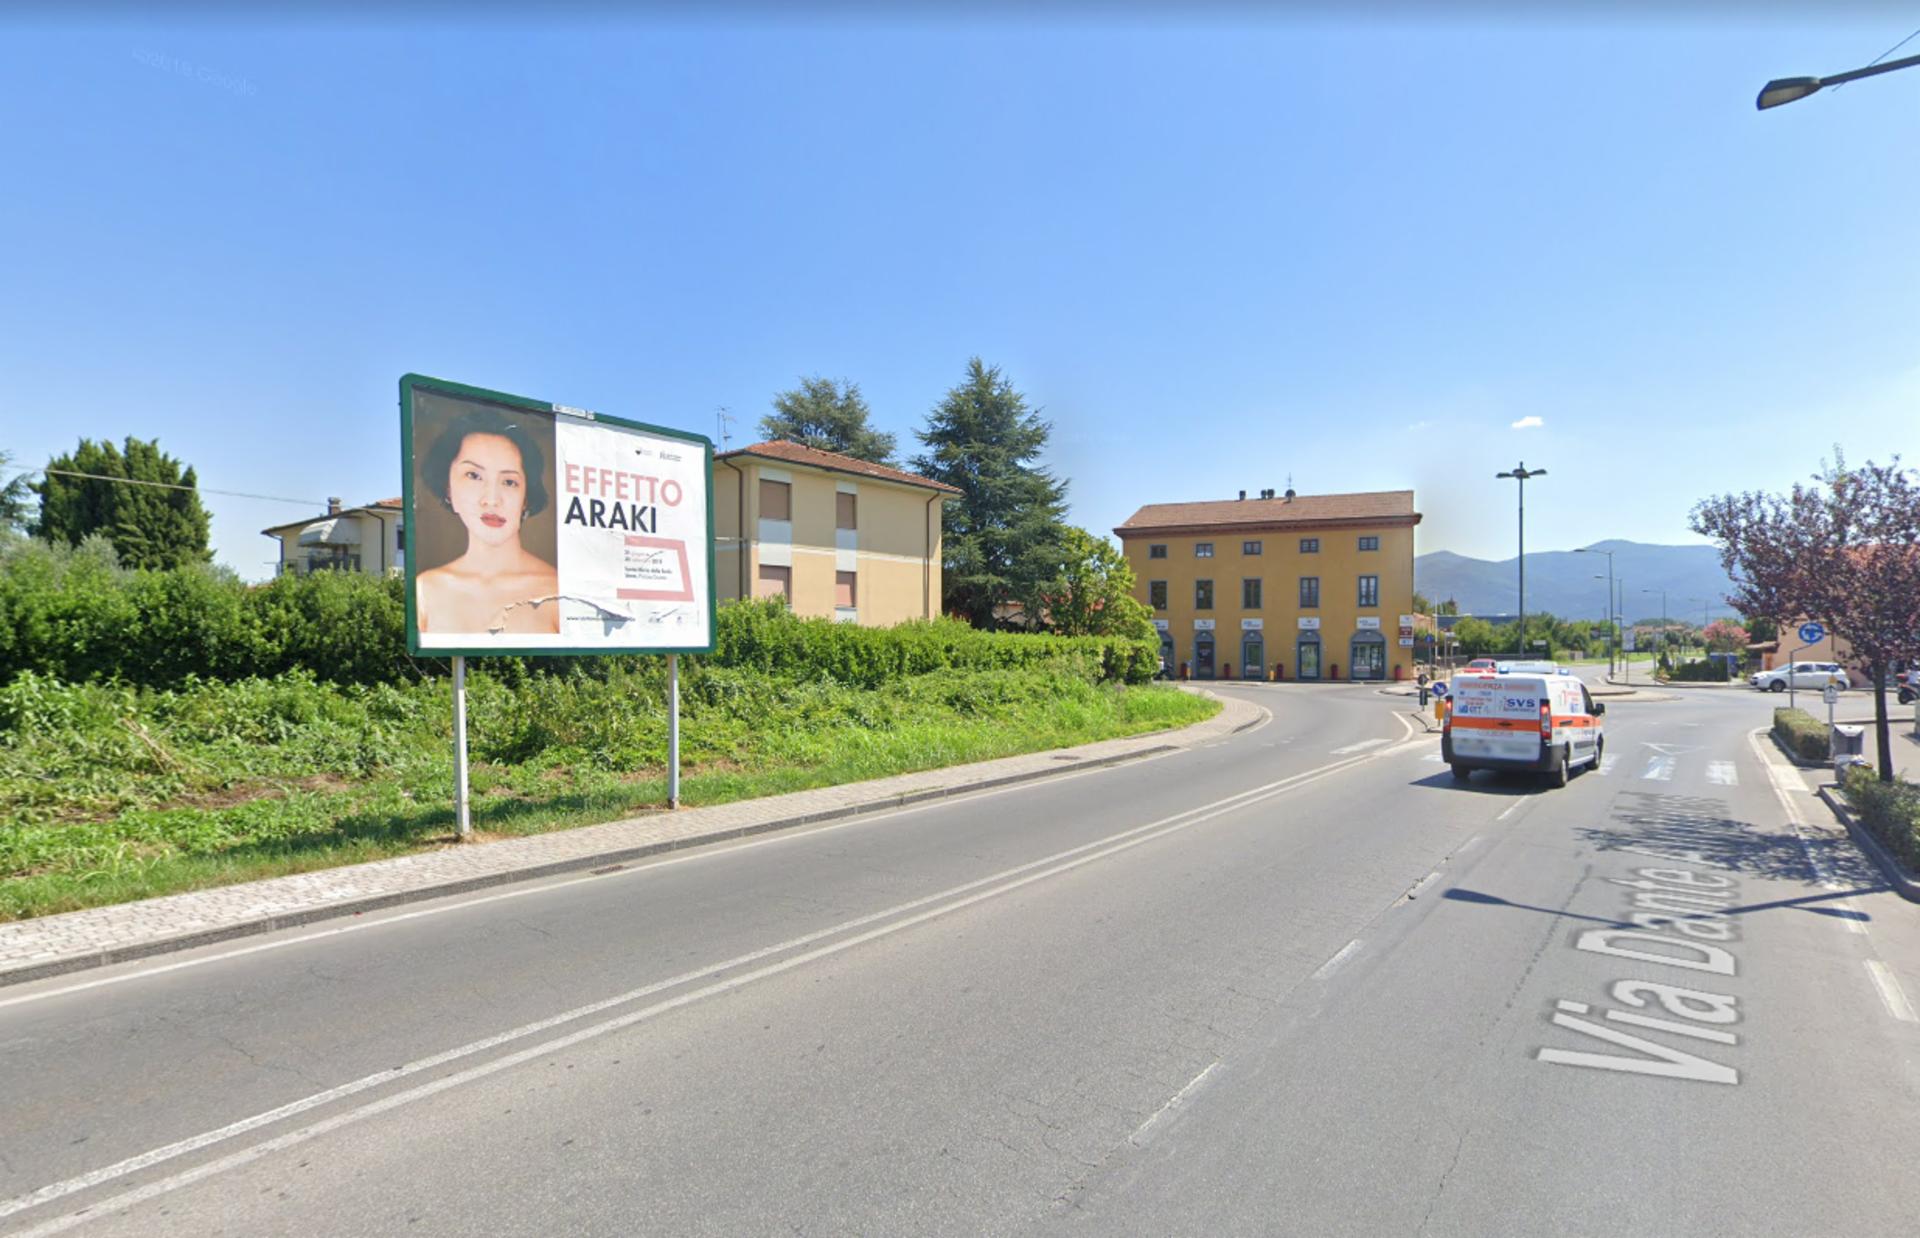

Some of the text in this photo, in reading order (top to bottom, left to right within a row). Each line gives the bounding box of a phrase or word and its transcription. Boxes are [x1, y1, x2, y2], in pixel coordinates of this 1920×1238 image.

[565, 464, 683, 507] EFFETTO
[564, 496, 657, 534] ARAKI
[1507, 698, 1536, 708] SVS
